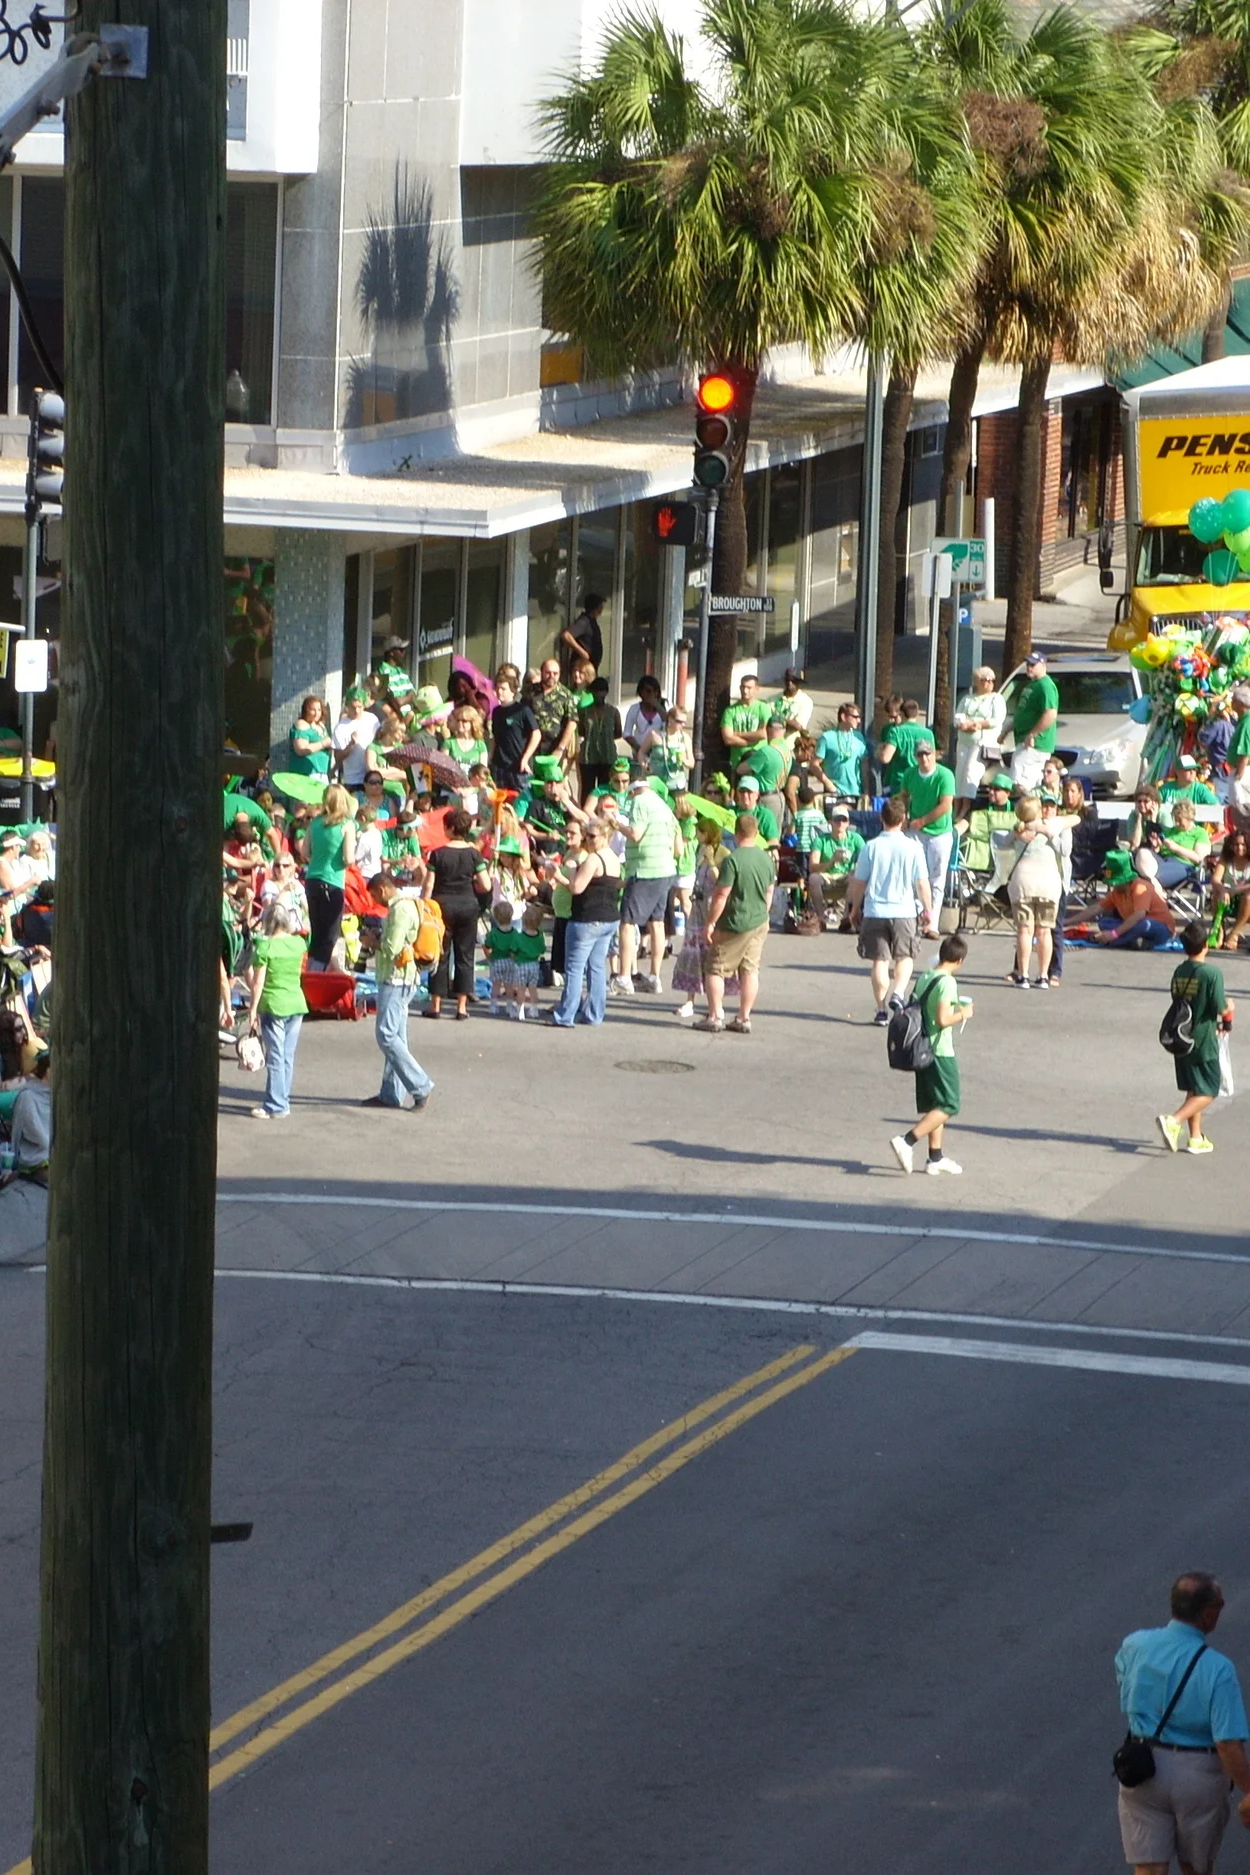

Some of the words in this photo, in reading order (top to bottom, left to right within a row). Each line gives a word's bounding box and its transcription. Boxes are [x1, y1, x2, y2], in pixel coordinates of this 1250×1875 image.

[1191, 461, 1230, 475] Truck
[970, 543, 984, 553] 30
[712, 596, 763, 612] BROUGHTON
